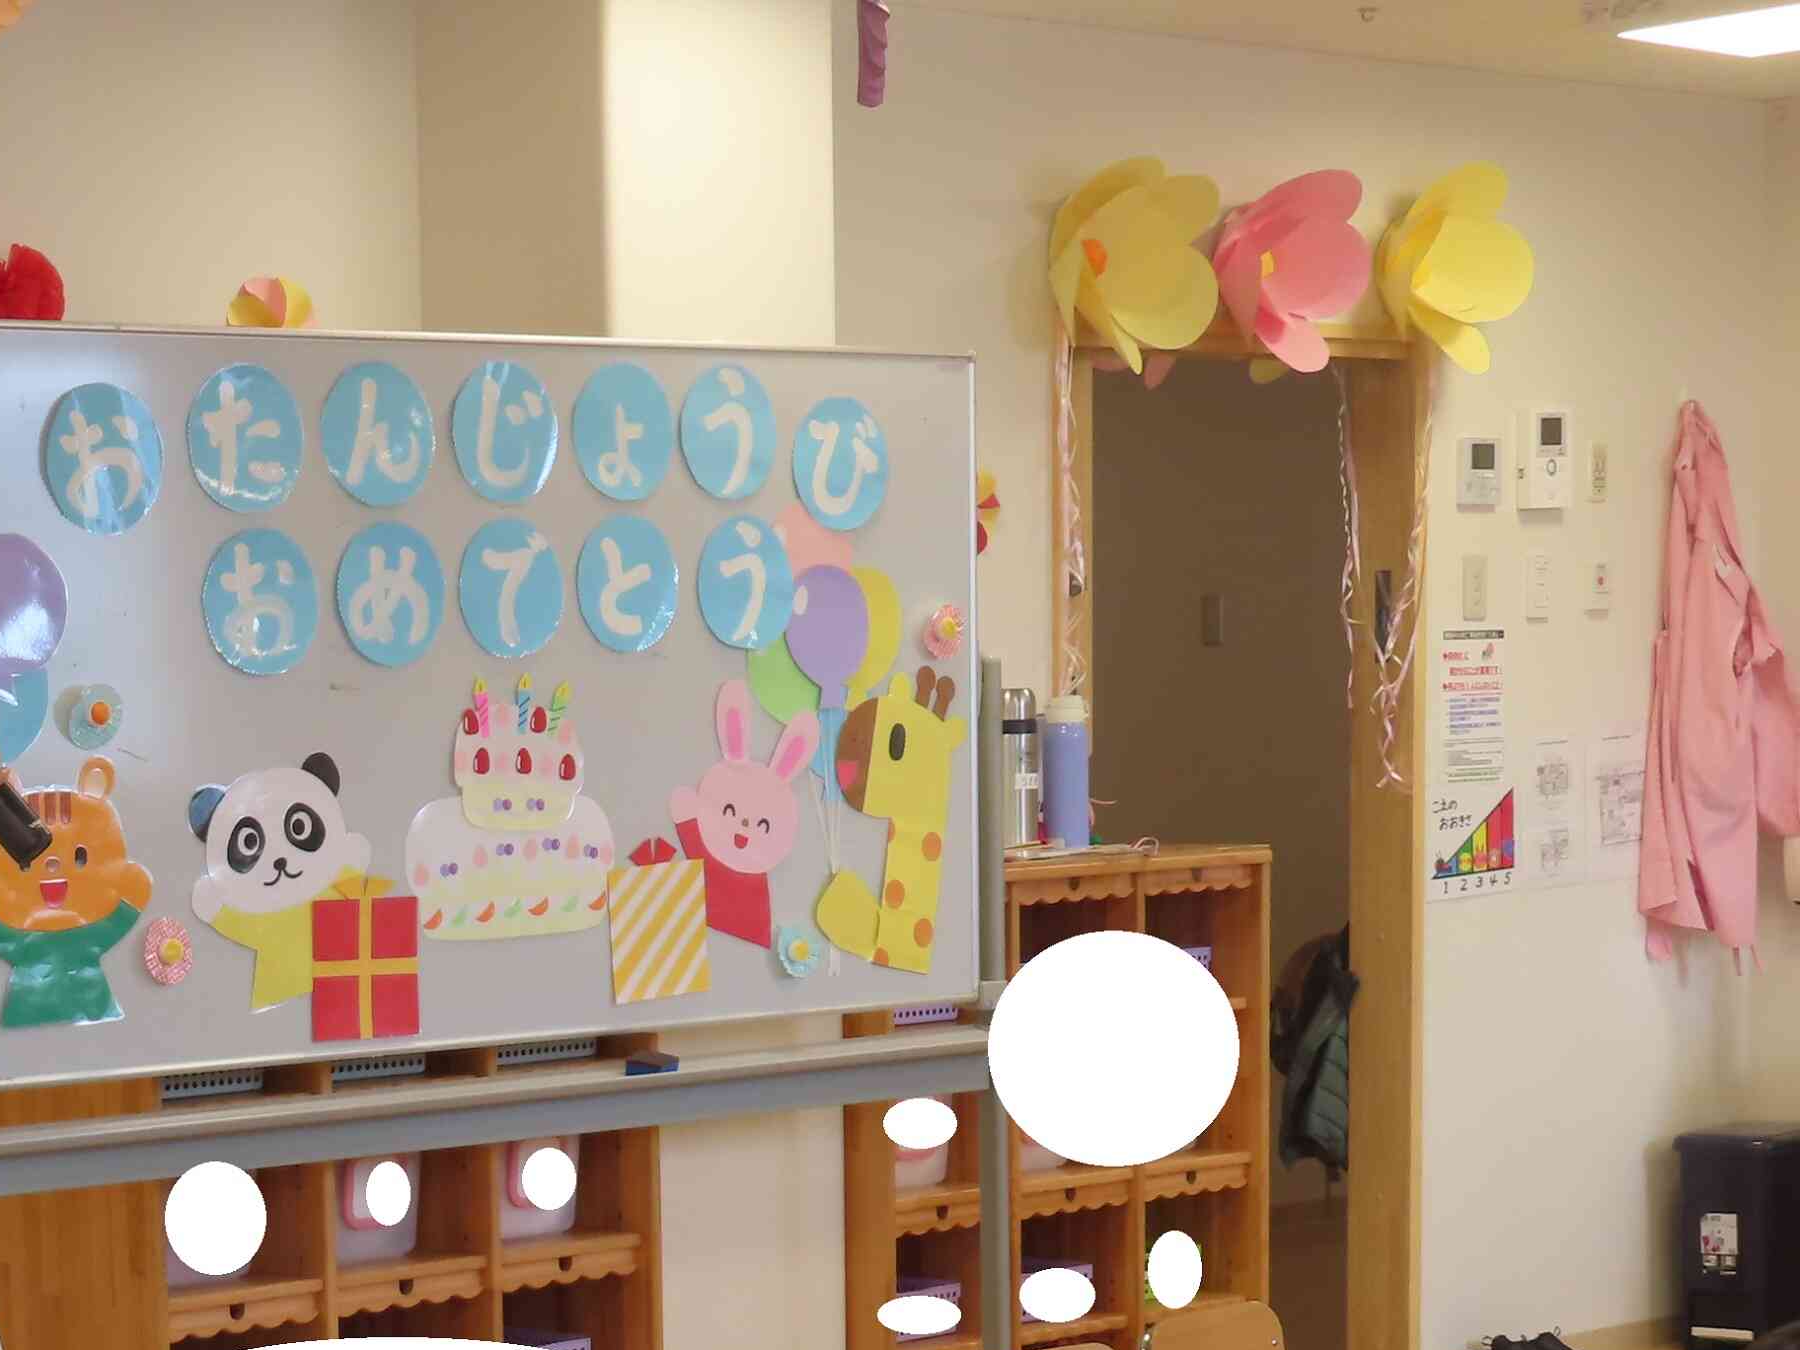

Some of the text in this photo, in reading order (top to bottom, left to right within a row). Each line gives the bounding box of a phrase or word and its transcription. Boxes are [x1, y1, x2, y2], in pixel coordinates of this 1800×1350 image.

[61, 366, 879, 518] おたんじょうび
[218, 522, 767, 660] おめでとう
[1443, 871, 1512, 894] 1 2 3 4 5
